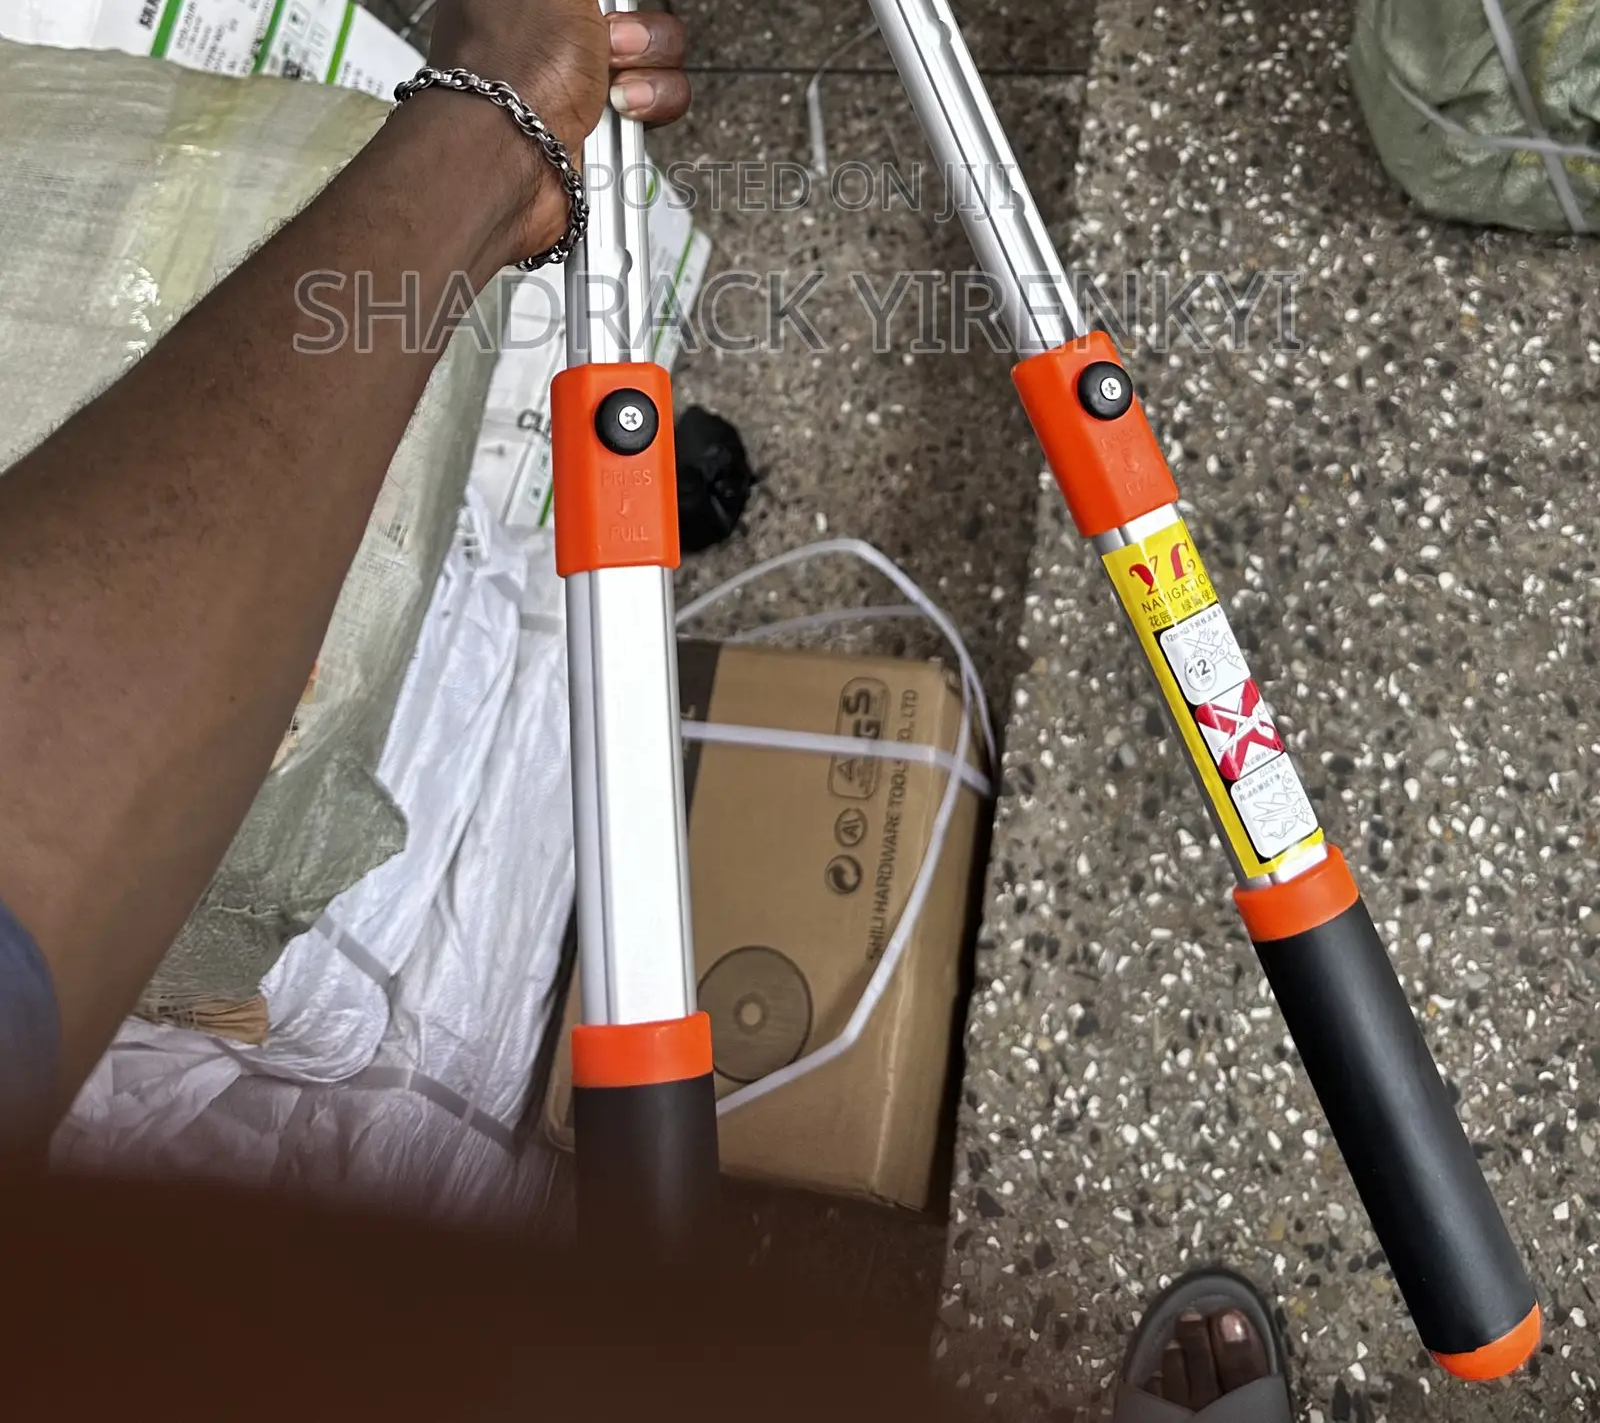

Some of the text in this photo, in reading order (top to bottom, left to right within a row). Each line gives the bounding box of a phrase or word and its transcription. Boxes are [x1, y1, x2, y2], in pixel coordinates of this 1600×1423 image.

[601, 469, 652, 486] PRESS
[609, 524, 650, 543] PULL
[874, 812, 902, 914] HARDWARE
